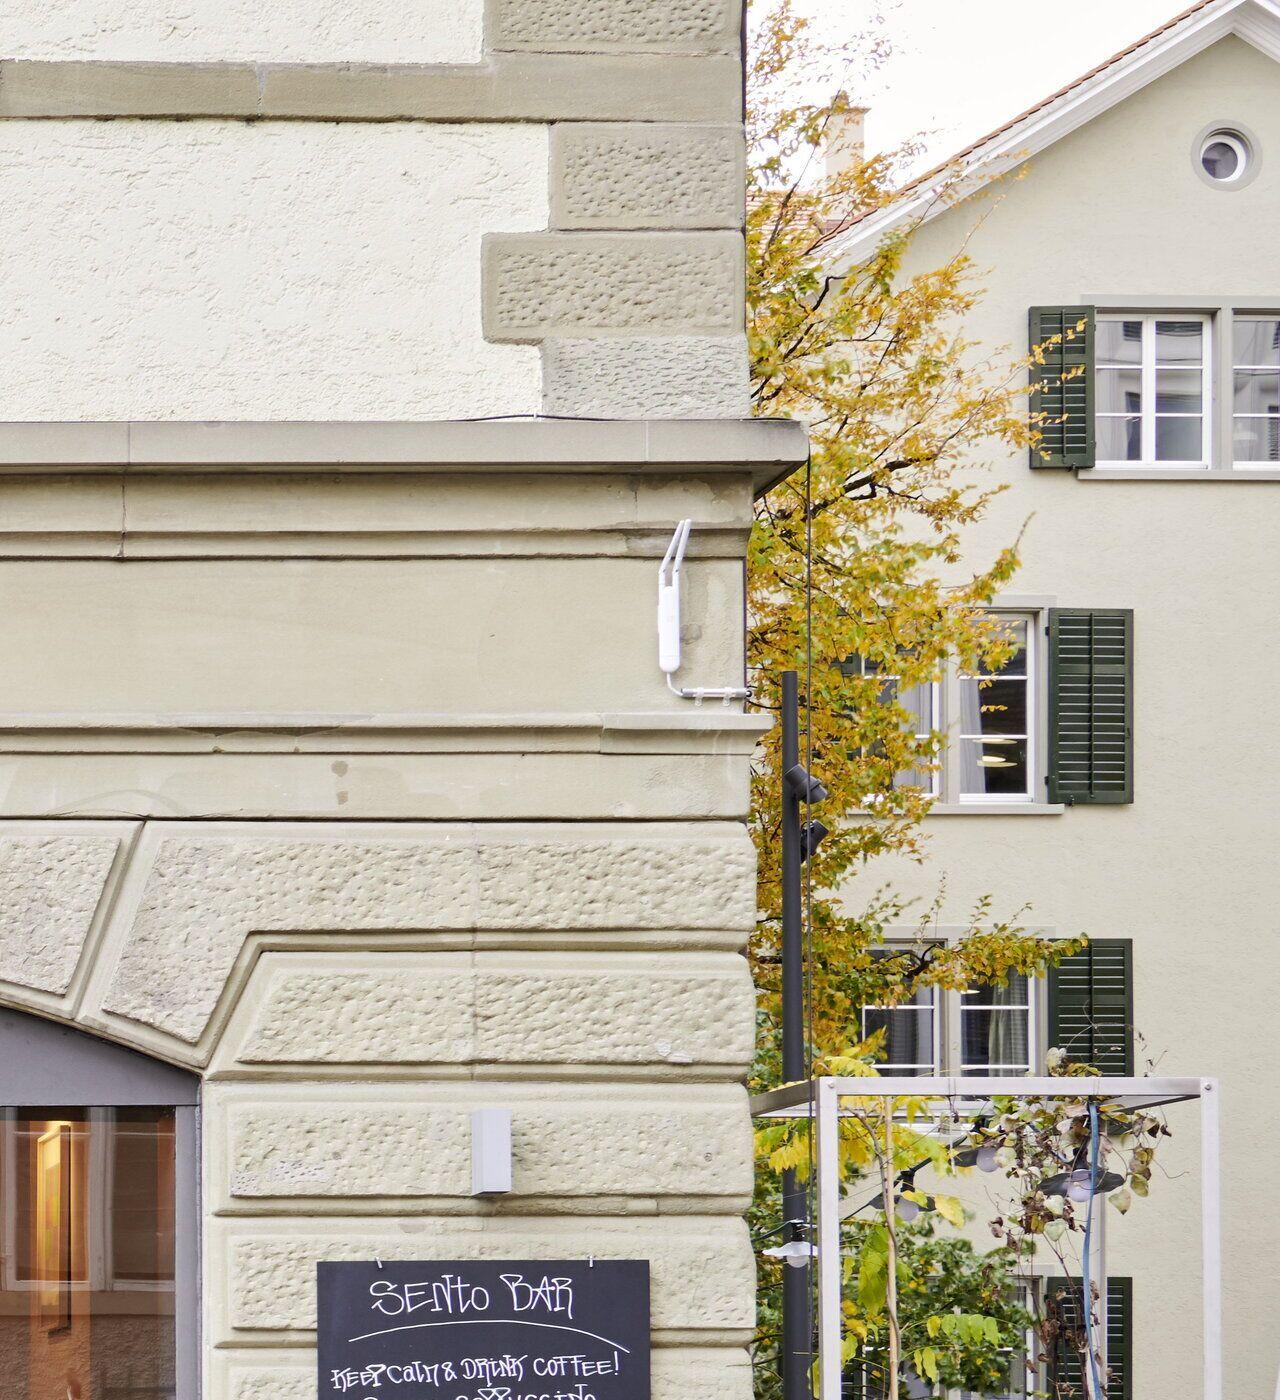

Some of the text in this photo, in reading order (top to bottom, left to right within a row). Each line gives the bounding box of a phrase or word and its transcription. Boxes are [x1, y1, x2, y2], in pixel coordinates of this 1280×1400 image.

[499, 1274, 573, 1319] BAR
[331, 1364, 386, 1392] KEEP
[441, 1358, 458, 1380] &
